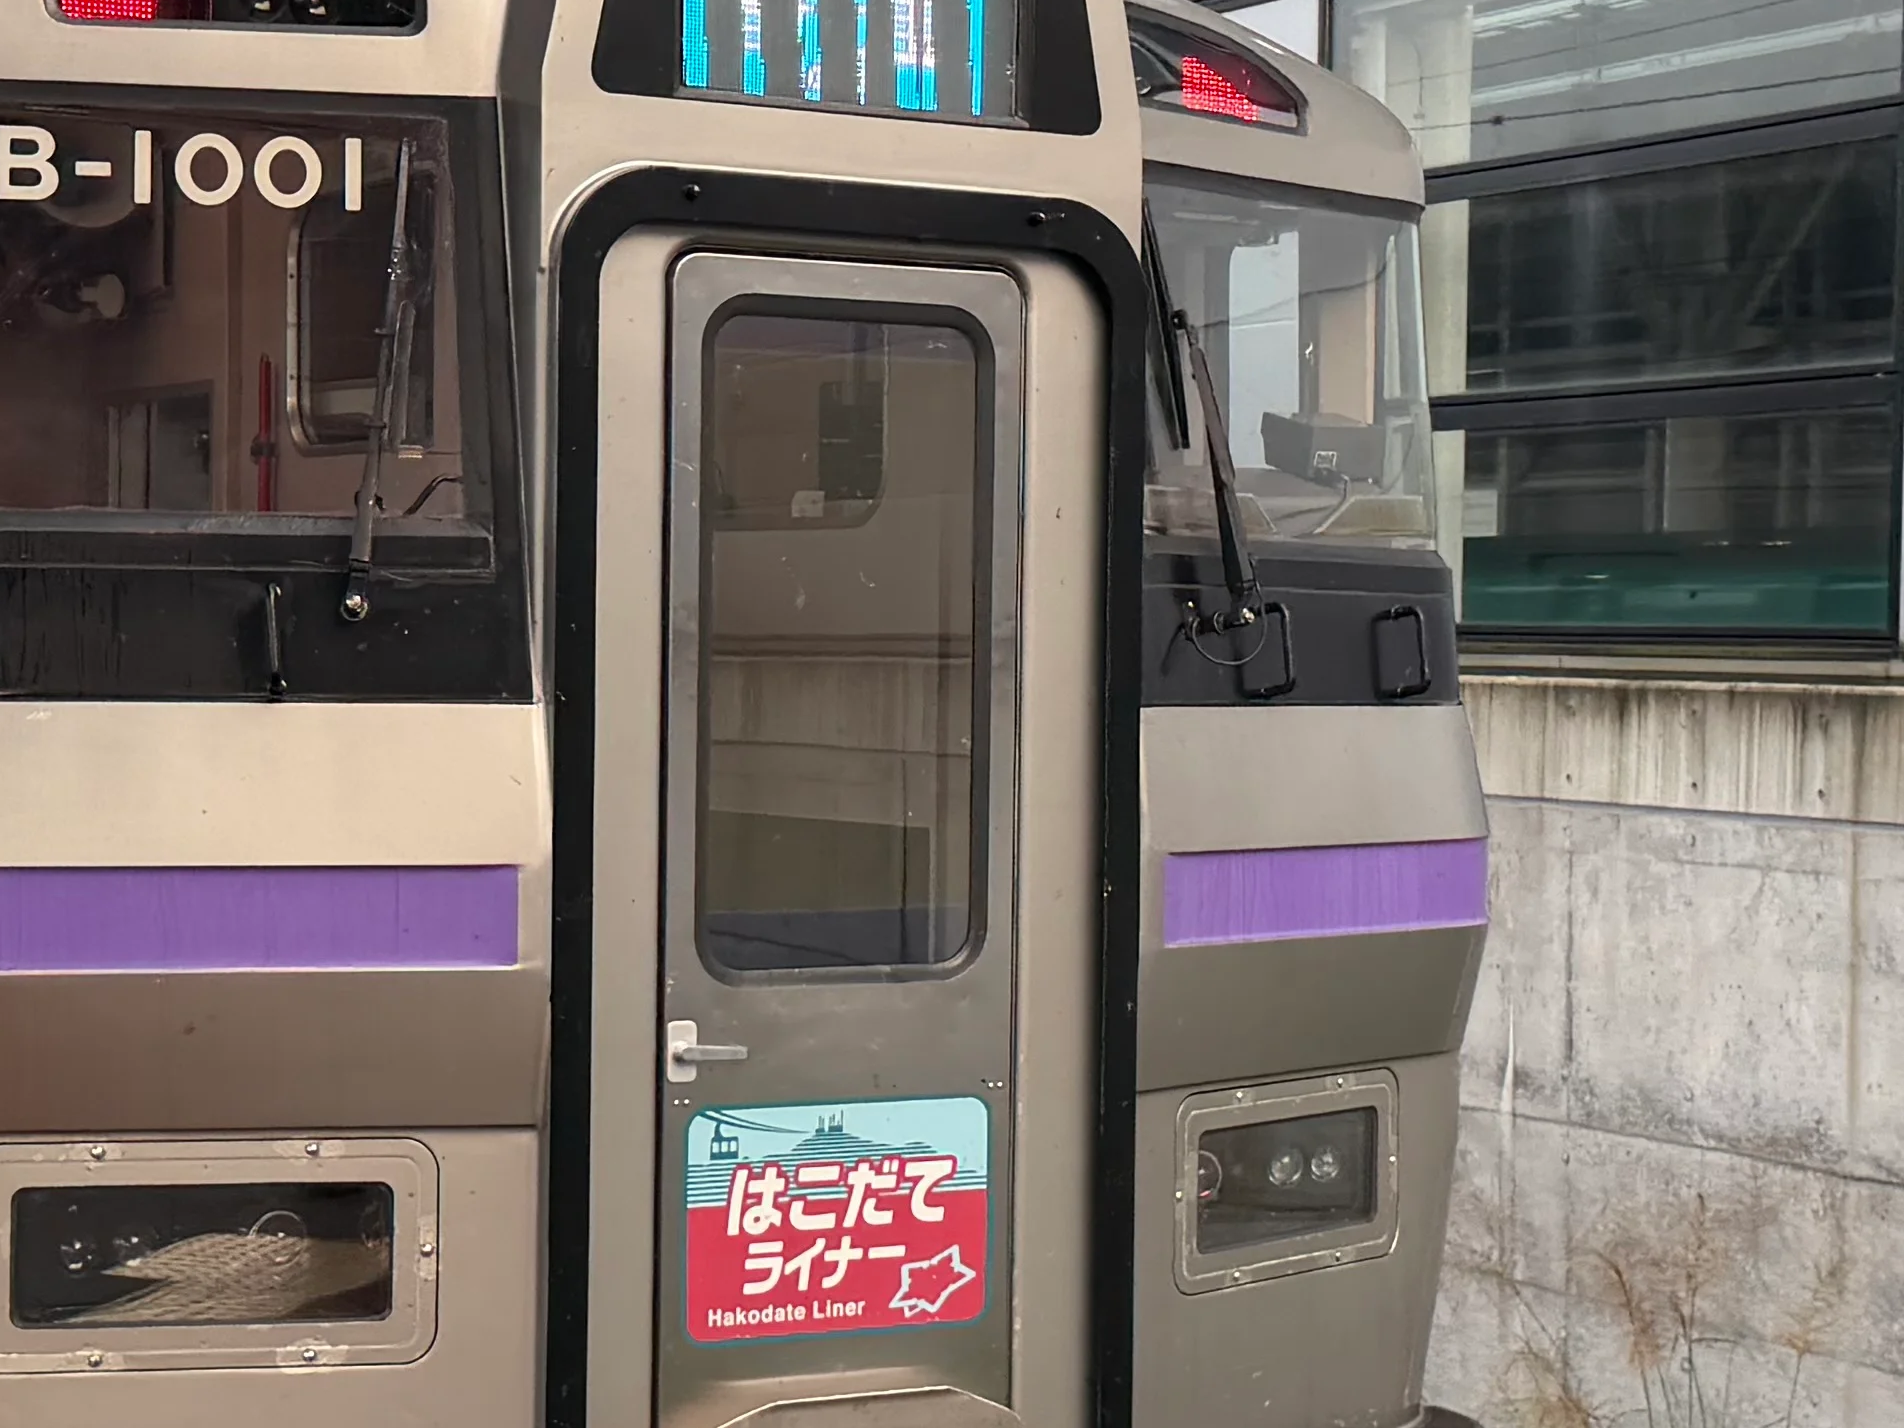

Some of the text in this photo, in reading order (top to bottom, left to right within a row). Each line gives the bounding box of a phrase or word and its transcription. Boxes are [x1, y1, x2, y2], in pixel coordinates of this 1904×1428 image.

[726, 1159, 954, 1236] はこだて
[741, 1235, 907, 1296] ライナー
[707, 1299, 866, 1328] Hakodate Liner
